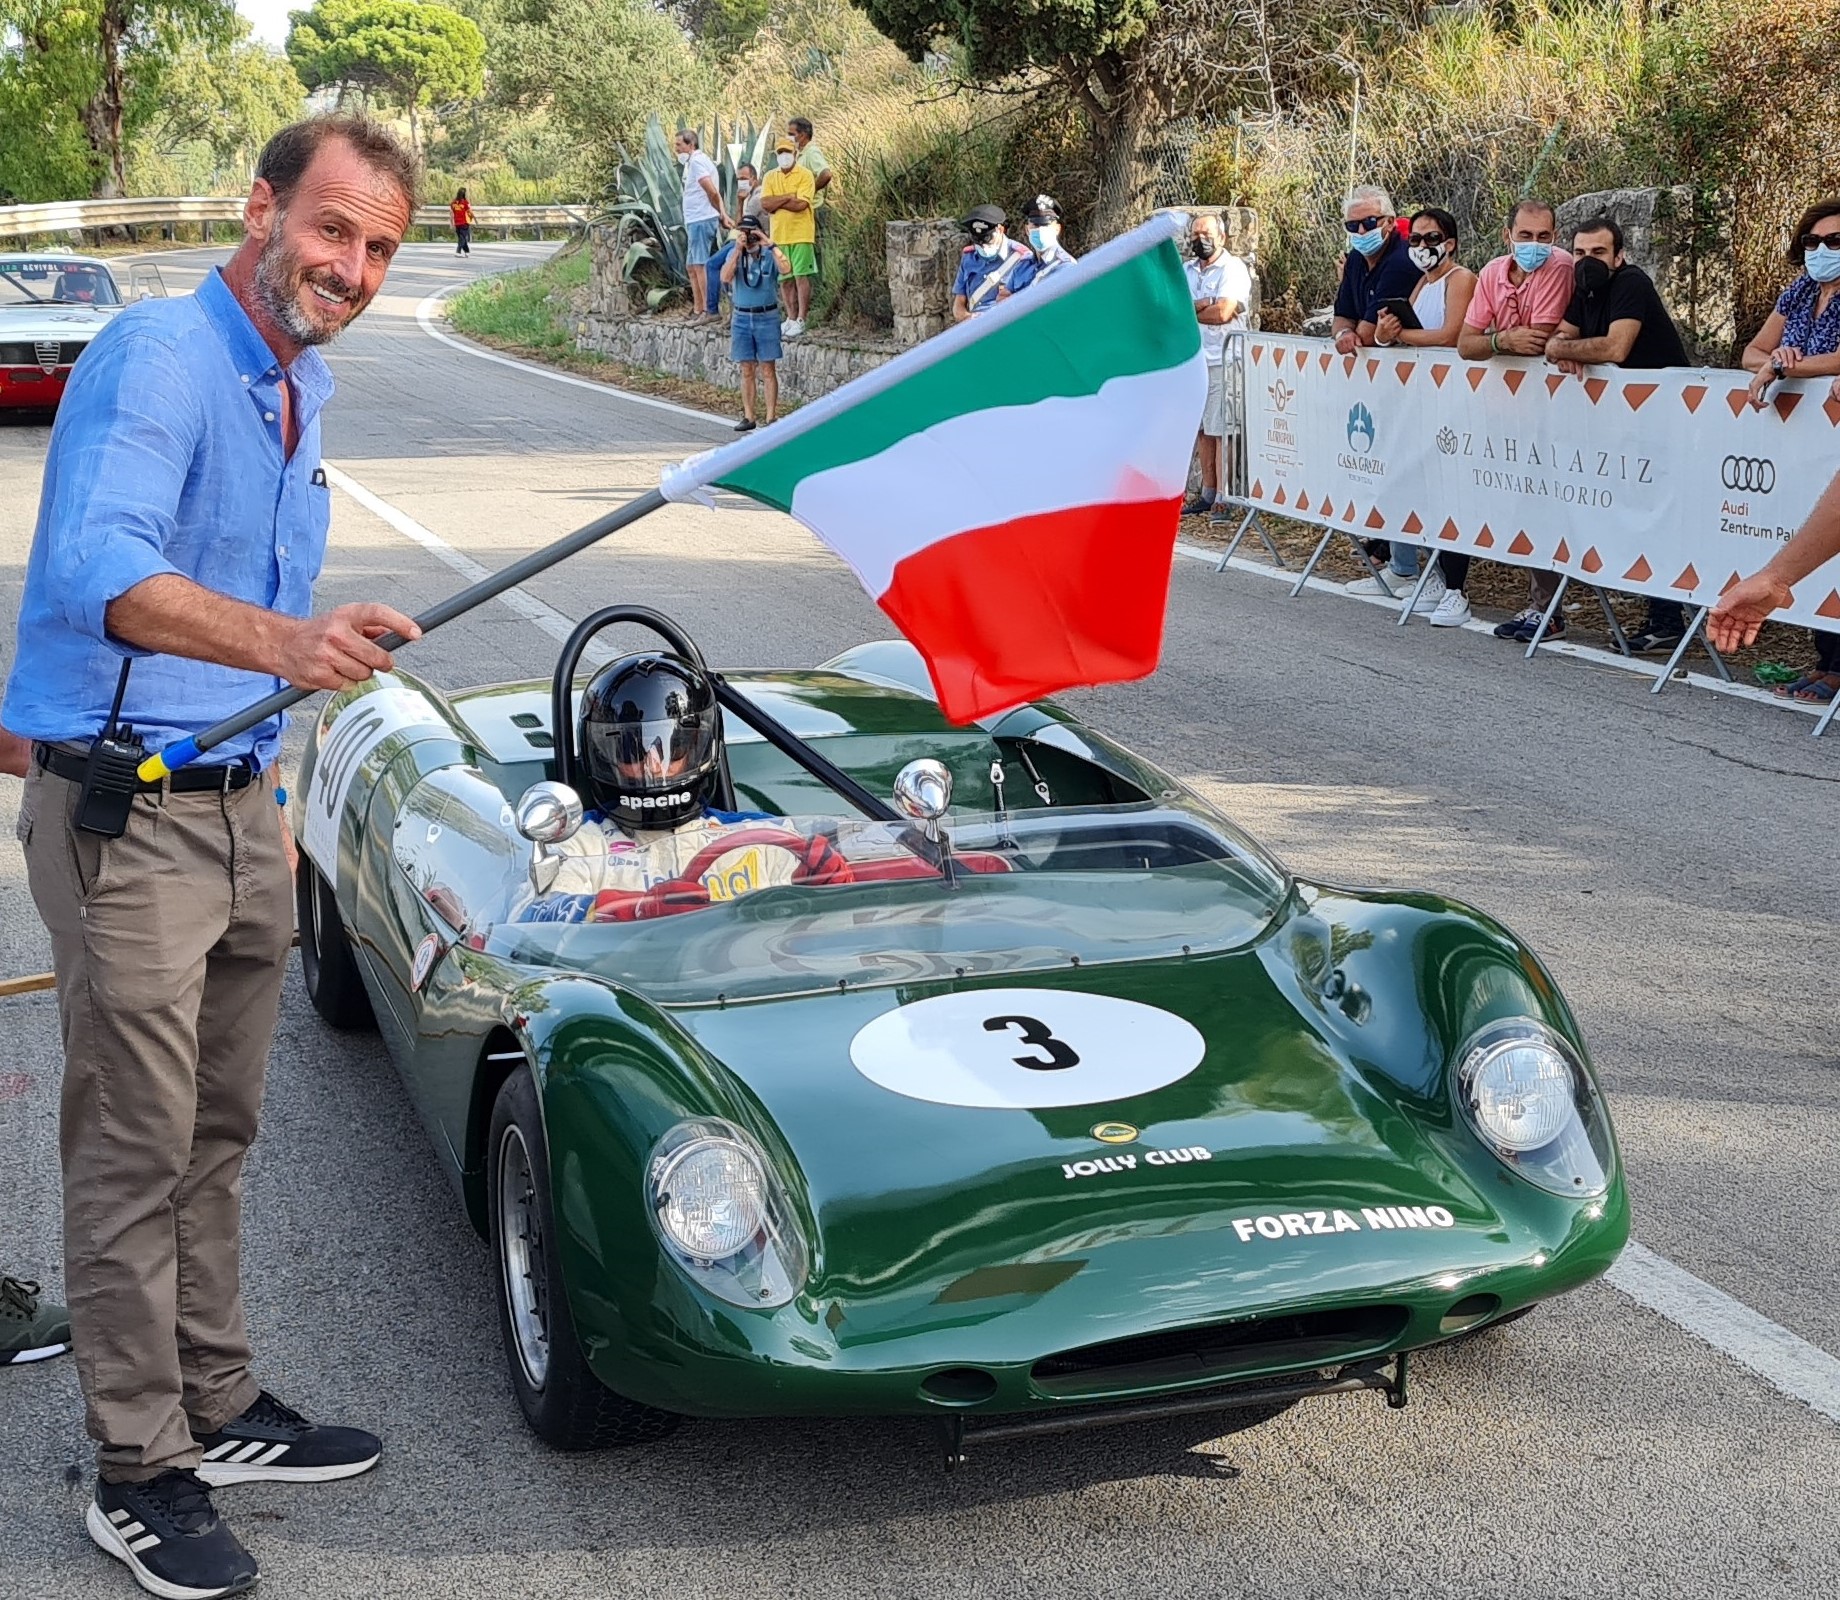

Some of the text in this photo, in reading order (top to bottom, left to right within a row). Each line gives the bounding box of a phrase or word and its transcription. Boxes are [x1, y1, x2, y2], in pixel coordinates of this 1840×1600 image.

[1337, 452, 1385, 476] CASA GRAZIA
[1472, 468, 1549, 496] TONNARA
[1721, 500, 1749, 516] Audi
[1720, 518, 1796, 541] Zentrum Pal
[642, 865, 752, 897] islnd
[982, 1015, 1081, 1071] 3
[1061, 1146, 1213, 1180] JOLLY CLUB
[1231, 1205, 1455, 1243] FORZA NINO
